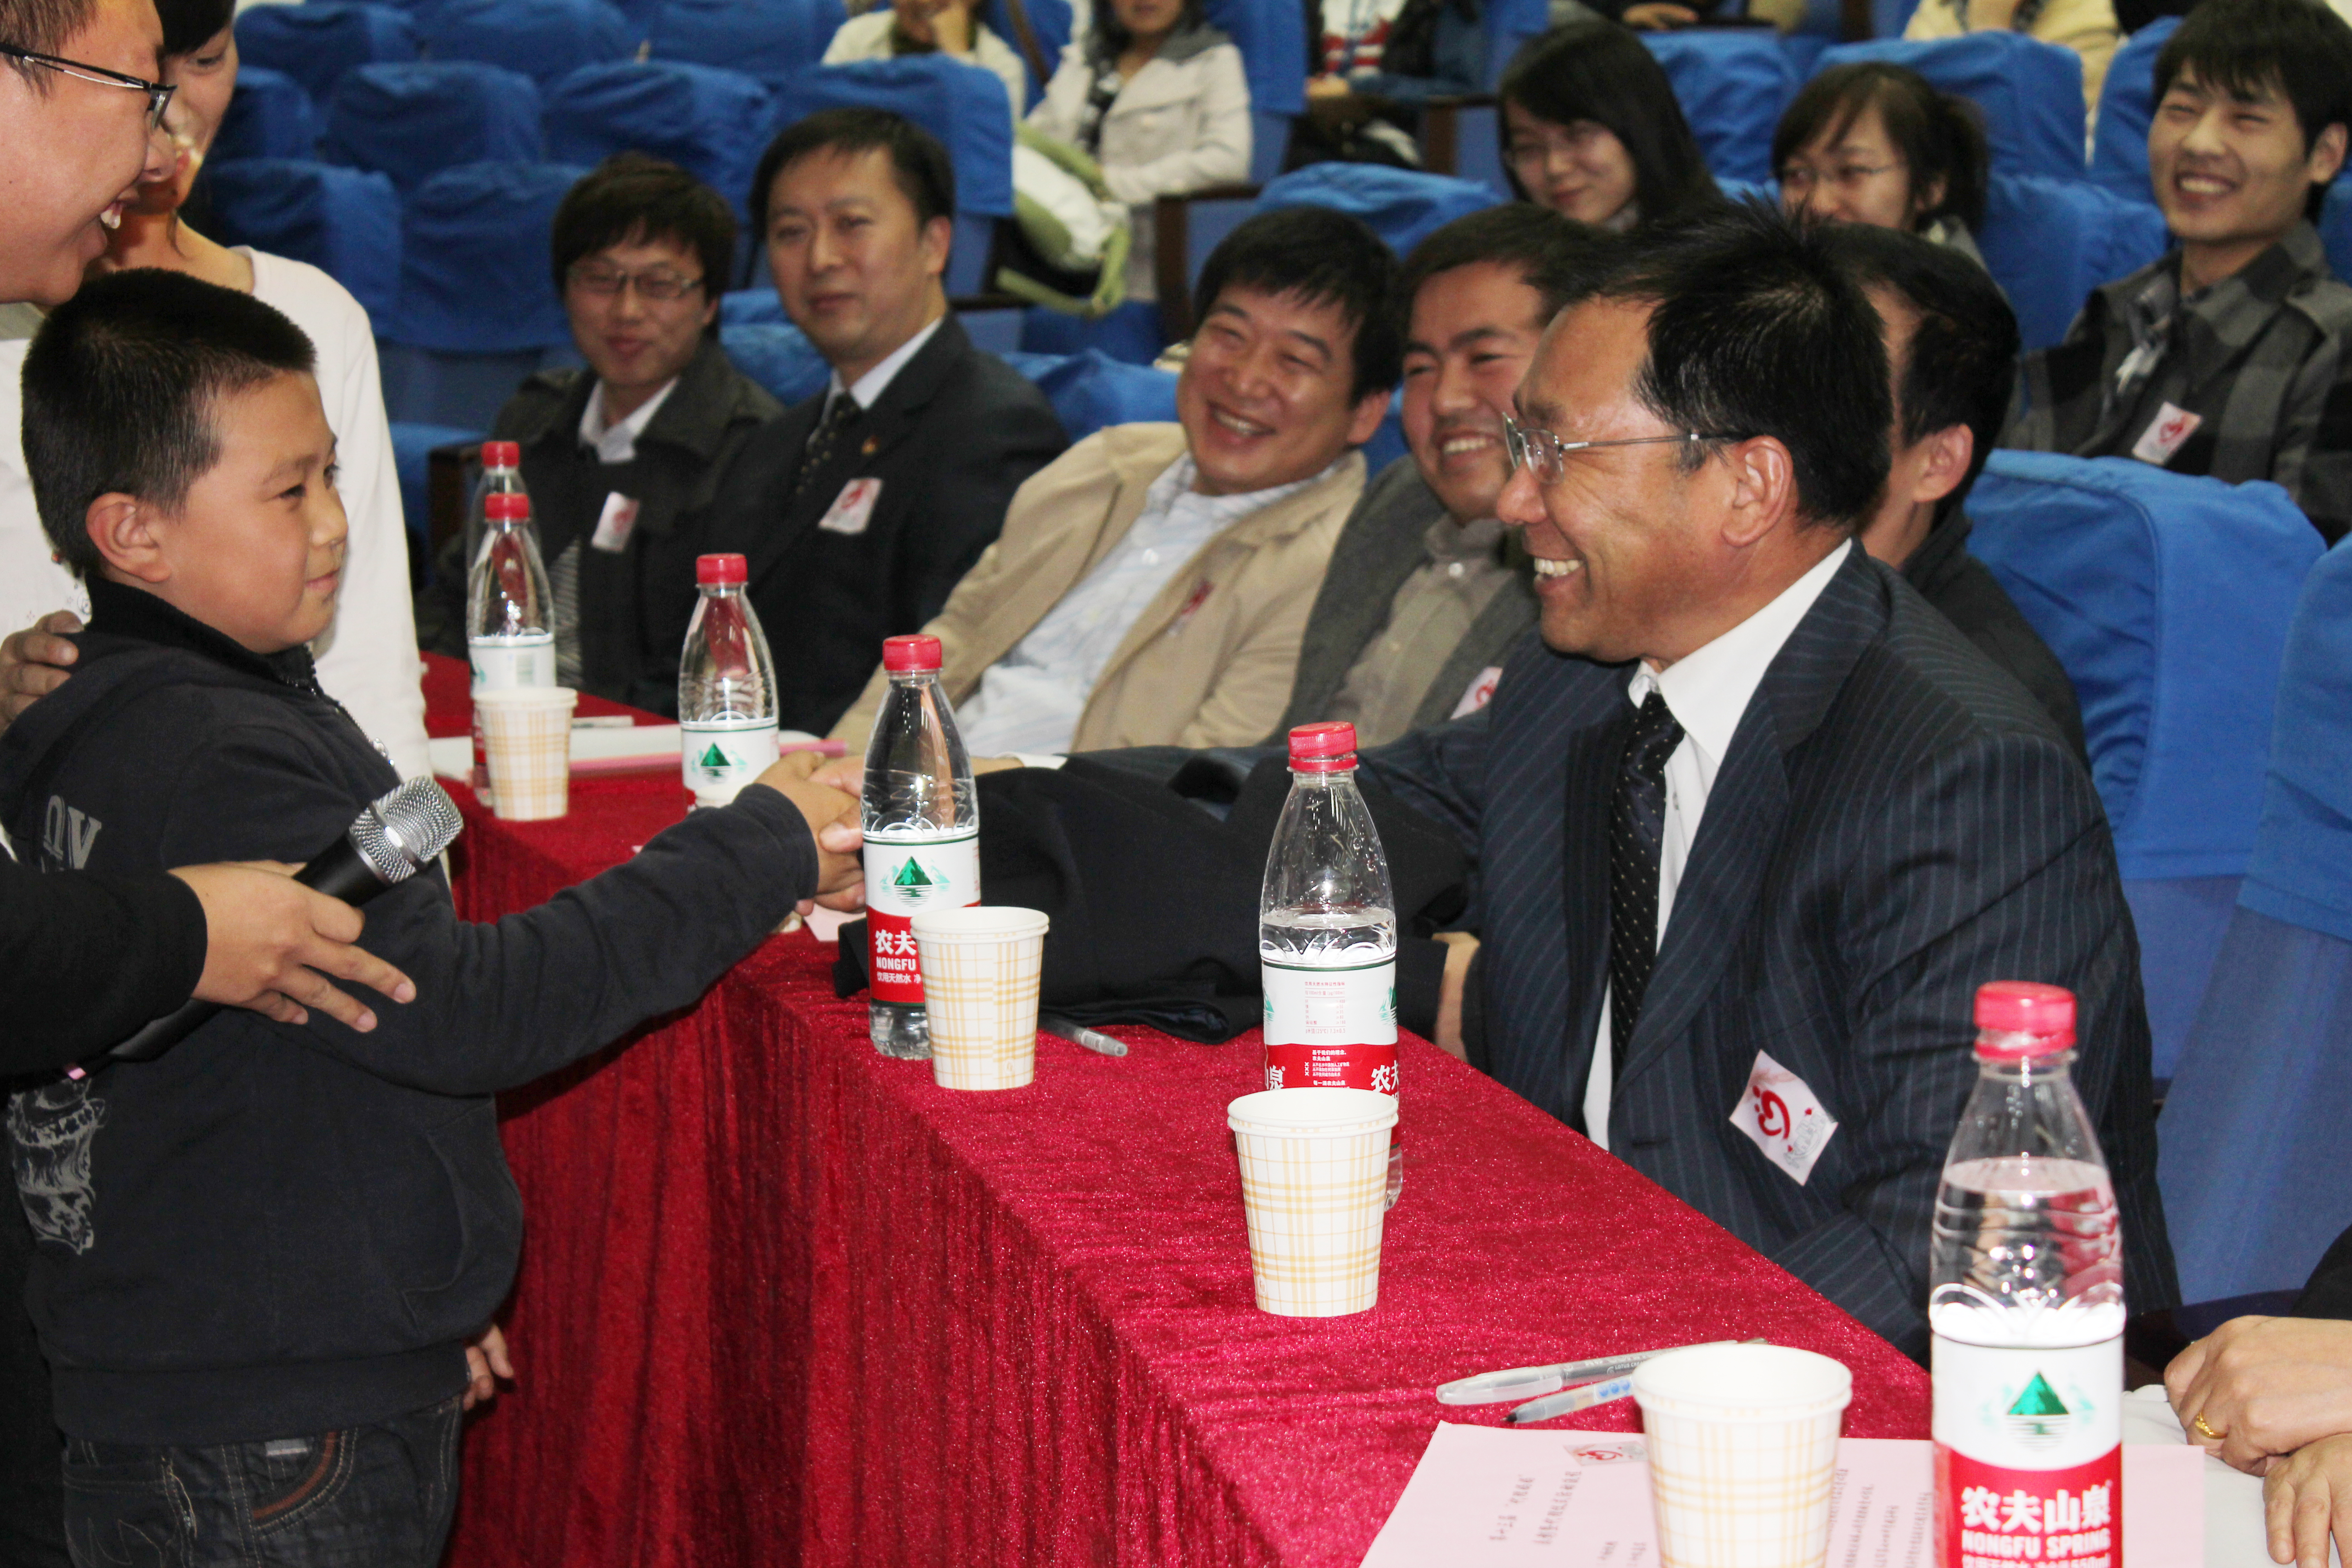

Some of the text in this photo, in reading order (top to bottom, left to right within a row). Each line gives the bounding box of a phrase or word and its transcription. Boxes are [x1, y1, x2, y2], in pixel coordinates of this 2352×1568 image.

[875, 929, 916, 956] 农夫
[876, 956, 916, 970] NONGFU
[877, 971, 911, 984] 饮用天然水
[1961, 1484, 2110, 1534] 农夫山泉
[1962, 1529, 2041, 1559] NONGFU
[2046, 1528, 2110, 1559] SPRING
